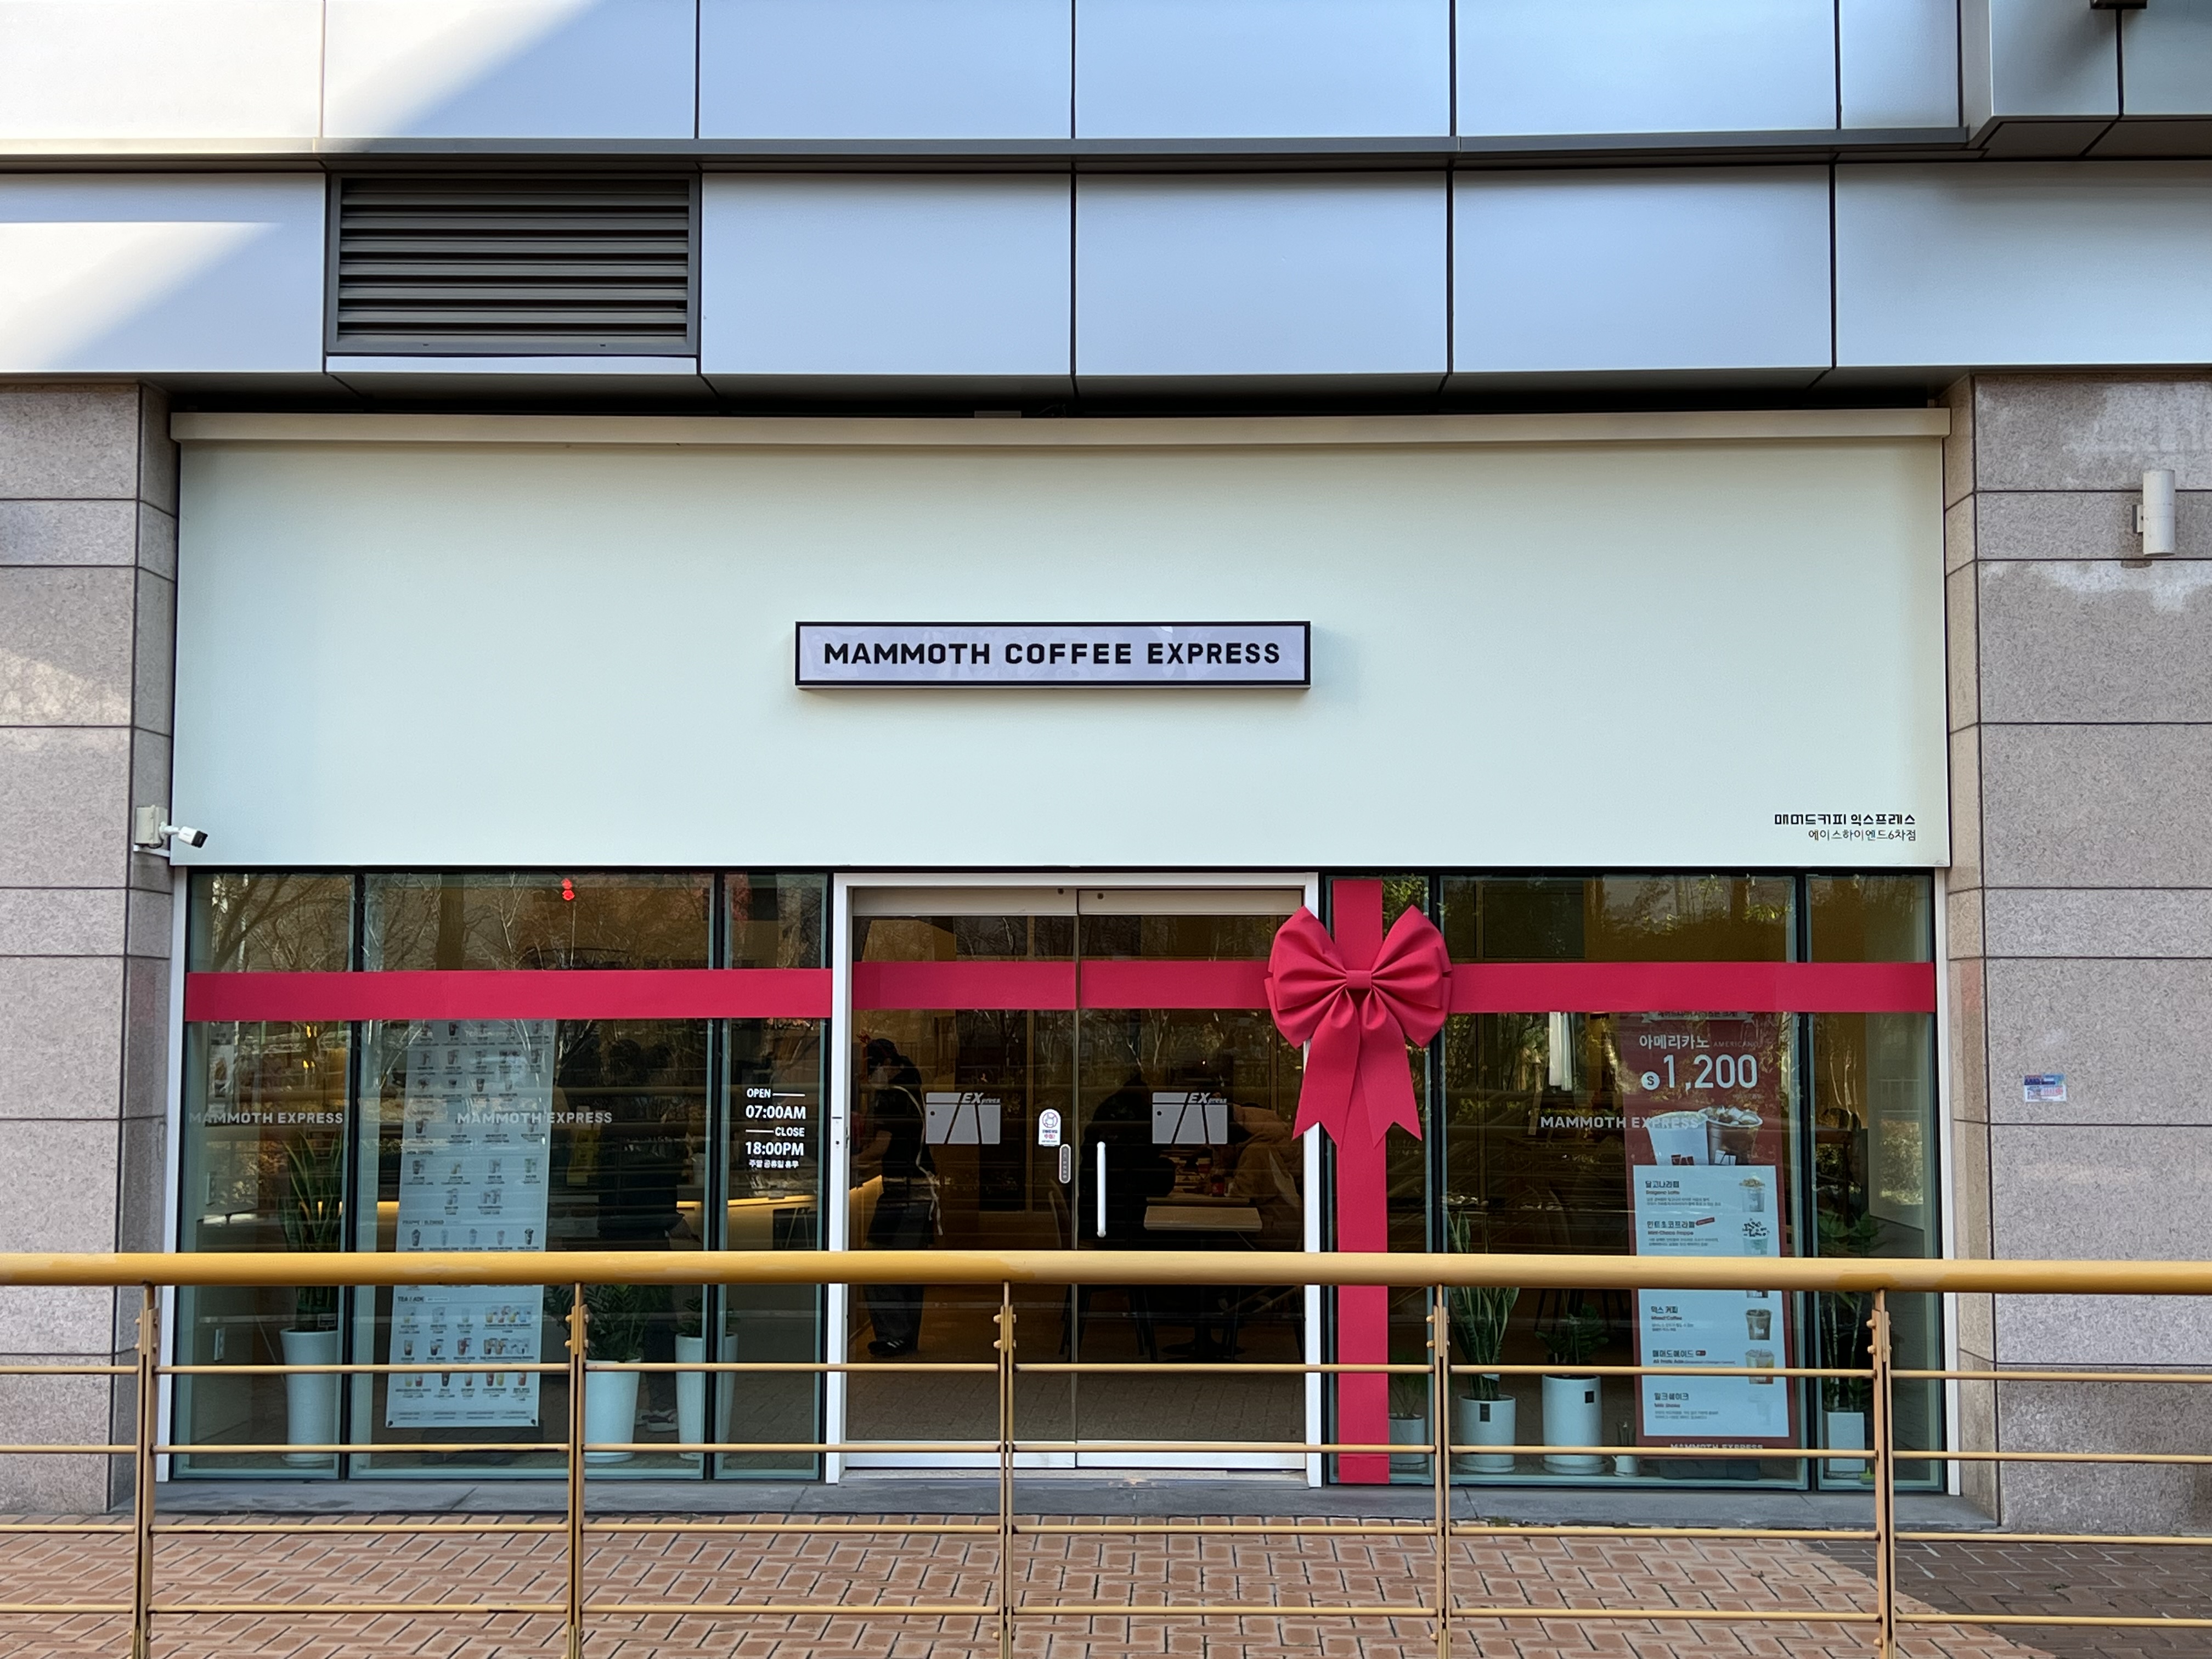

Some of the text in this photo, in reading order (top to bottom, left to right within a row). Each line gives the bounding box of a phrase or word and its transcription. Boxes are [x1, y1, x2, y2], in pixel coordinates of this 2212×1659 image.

[824, 643, 1280, 664] MAMMOTH COFFEE EXPRESS
[1850, 814, 1916, 826] 익스프레스
[1808, 829, 1916, 841] 에이스하이엔드6차점
[1639, 1034, 1710, 1049] 아메리카노
[1663, 1054, 1758, 1094] 1,200
[746, 1088, 771, 1098] OPEN
[189, 1112, 343, 1124] MAMMOTH EXPRESS
[457, 1112, 613, 1124] MAMMOTH EXPRESS
[745, 1105, 806, 1119] 07:00AM
[1540, 1116, 1699, 1129] MAMMOTH EXPRESS
[775, 1126, 805, 1137] CLOSE
[745, 1141, 804, 1156] 18:00PM
